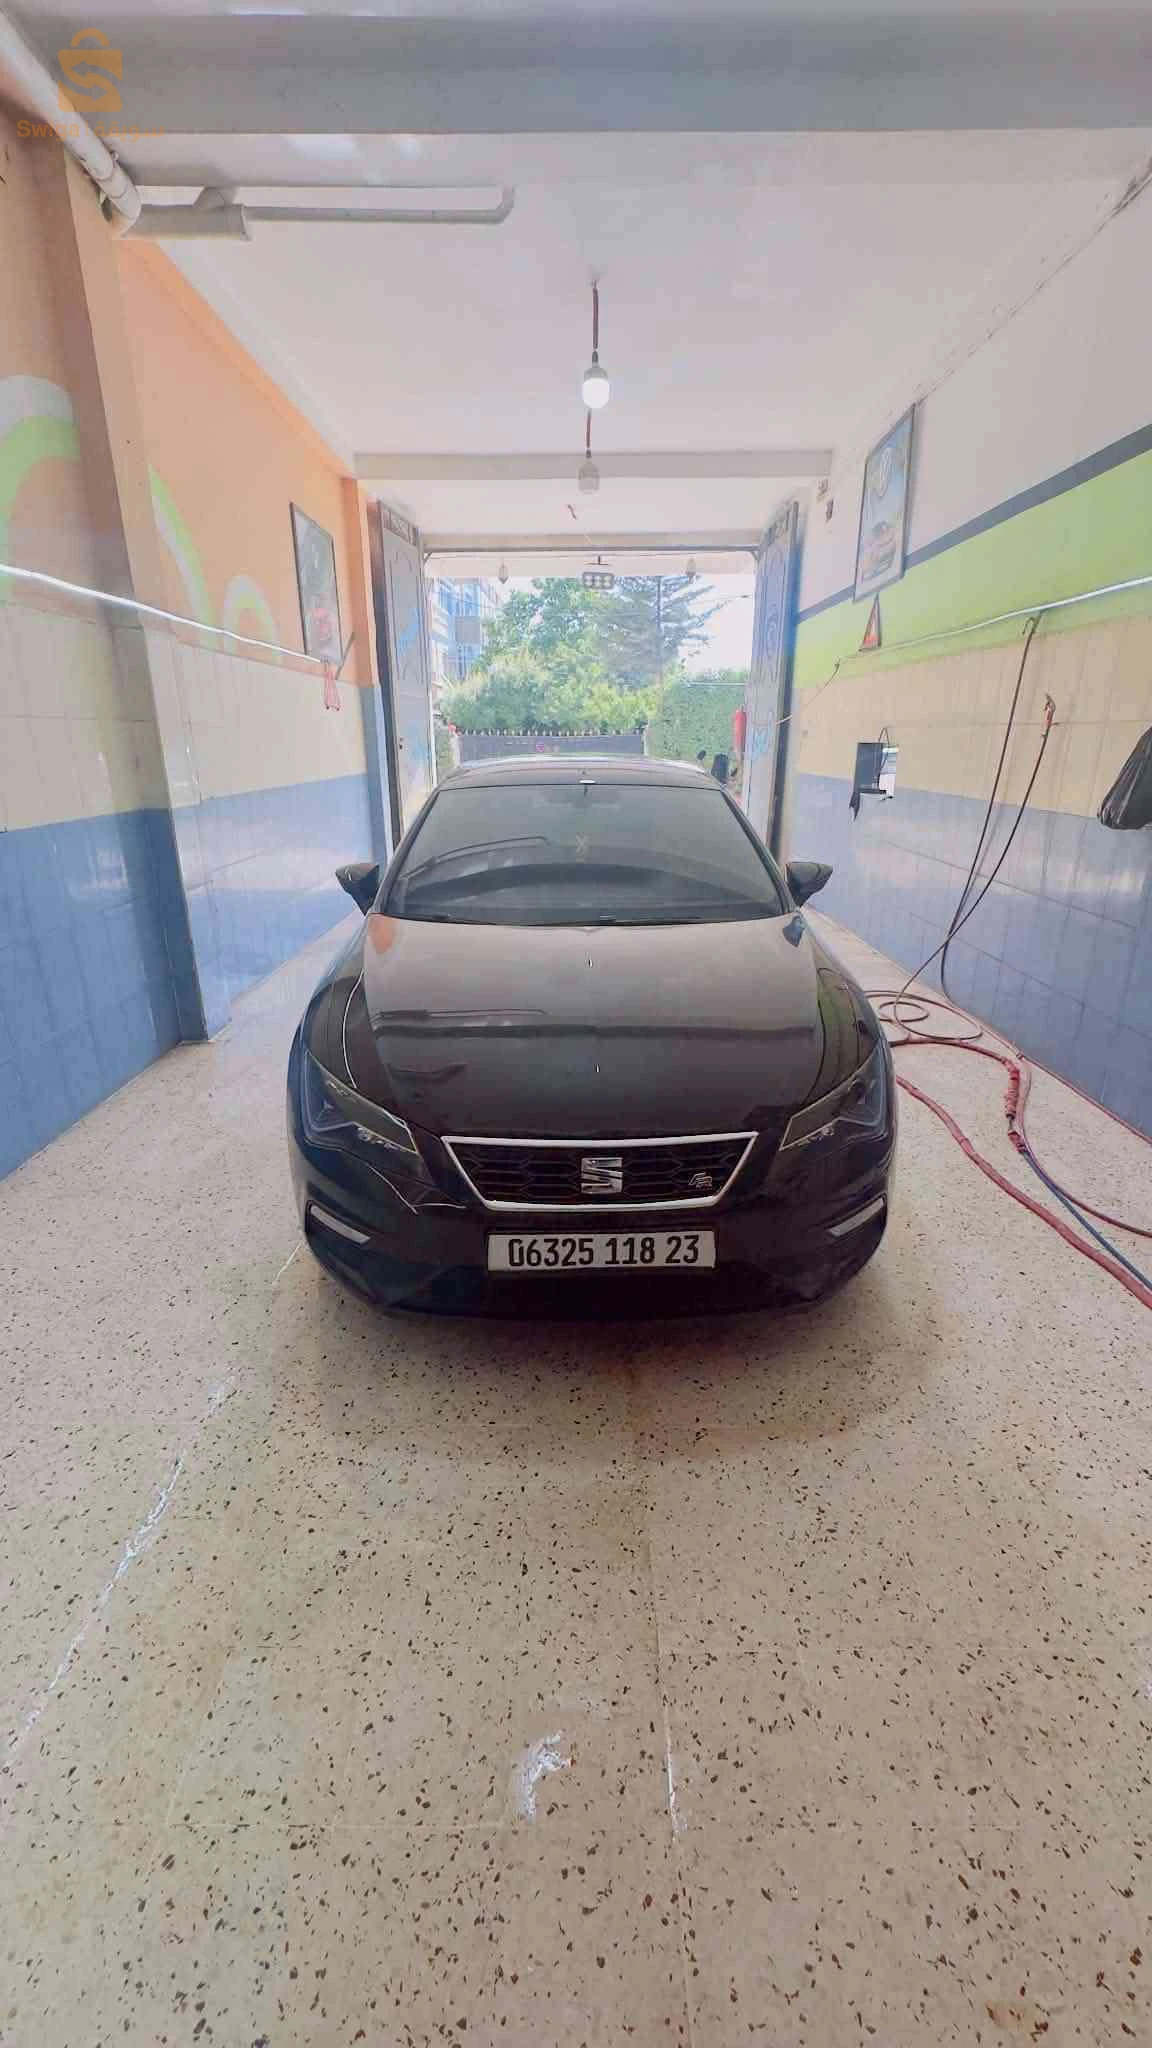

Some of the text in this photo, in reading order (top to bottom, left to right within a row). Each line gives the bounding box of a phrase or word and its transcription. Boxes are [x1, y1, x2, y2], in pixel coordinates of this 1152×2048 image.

[508, 1235, 700, 1267] 06325 118 23
